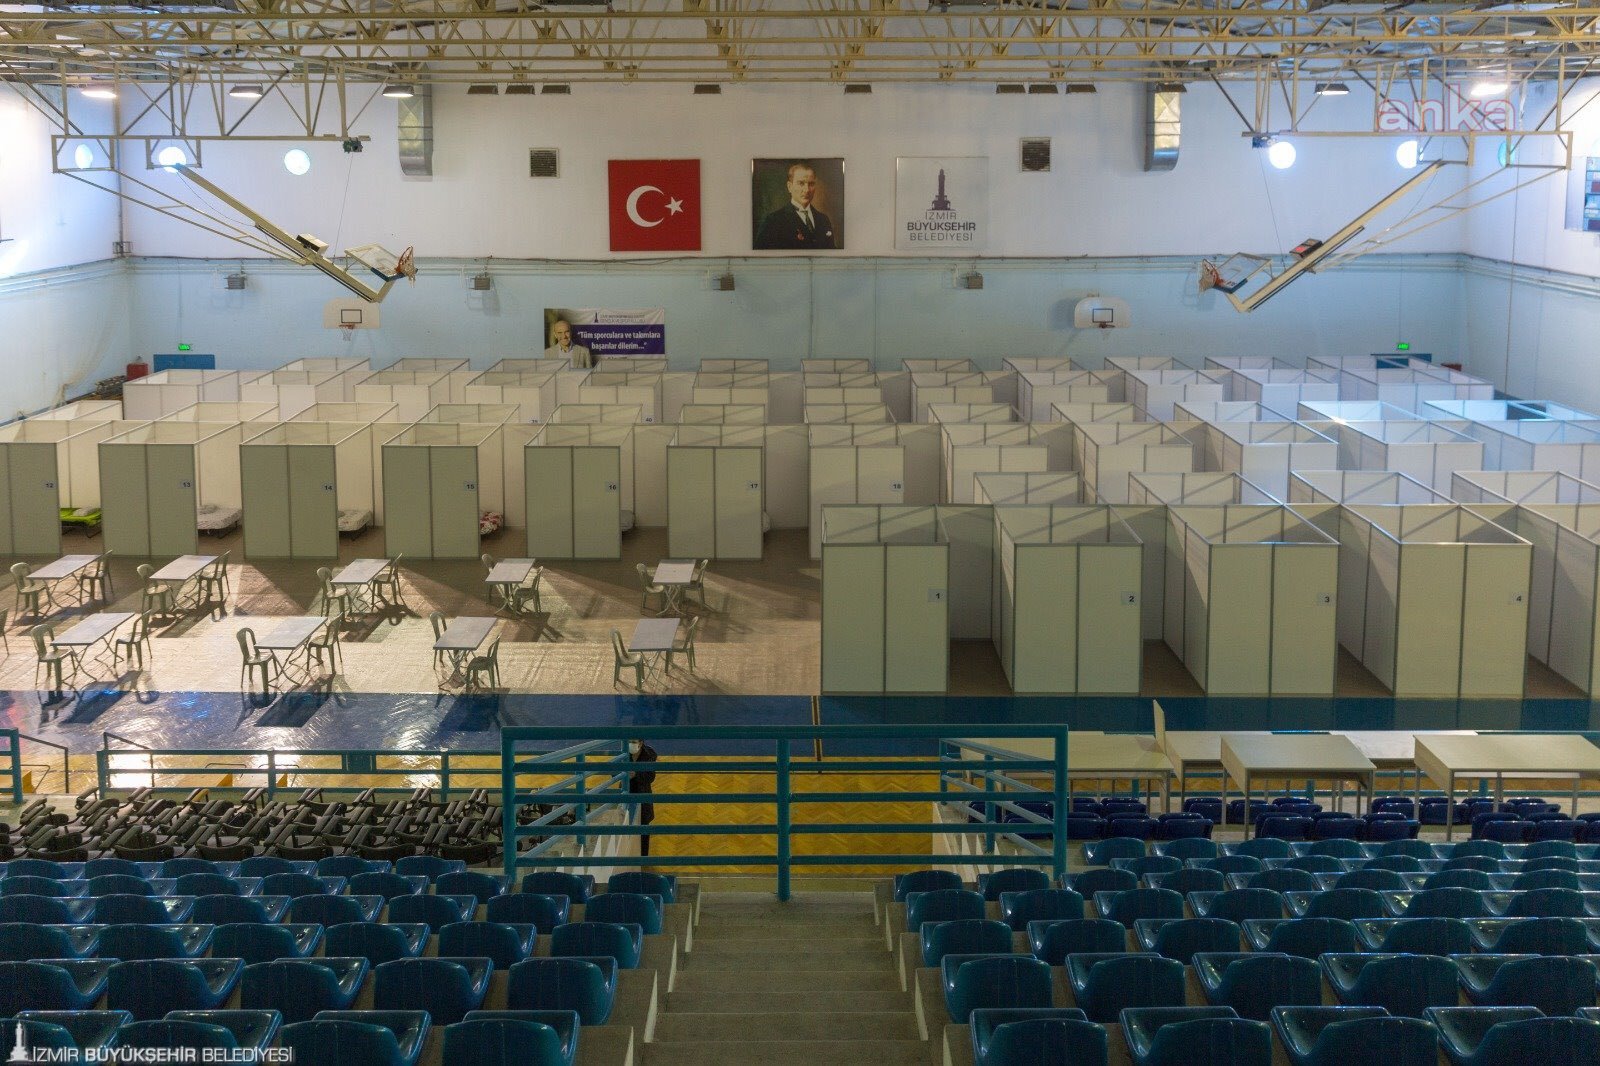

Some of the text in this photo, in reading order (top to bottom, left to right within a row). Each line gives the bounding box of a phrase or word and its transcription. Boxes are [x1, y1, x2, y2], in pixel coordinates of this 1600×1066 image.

[925, 211, 957, 220] İZMİR
[907, 220, 976, 232] BÜYÜKŞEHİR
[909, 232, 973, 241] BELEDİYESİ
[593, 331, 624, 340] sporculara
[632, 331, 661, 339] takımlara
[591, 342, 617, 351] başarılar
